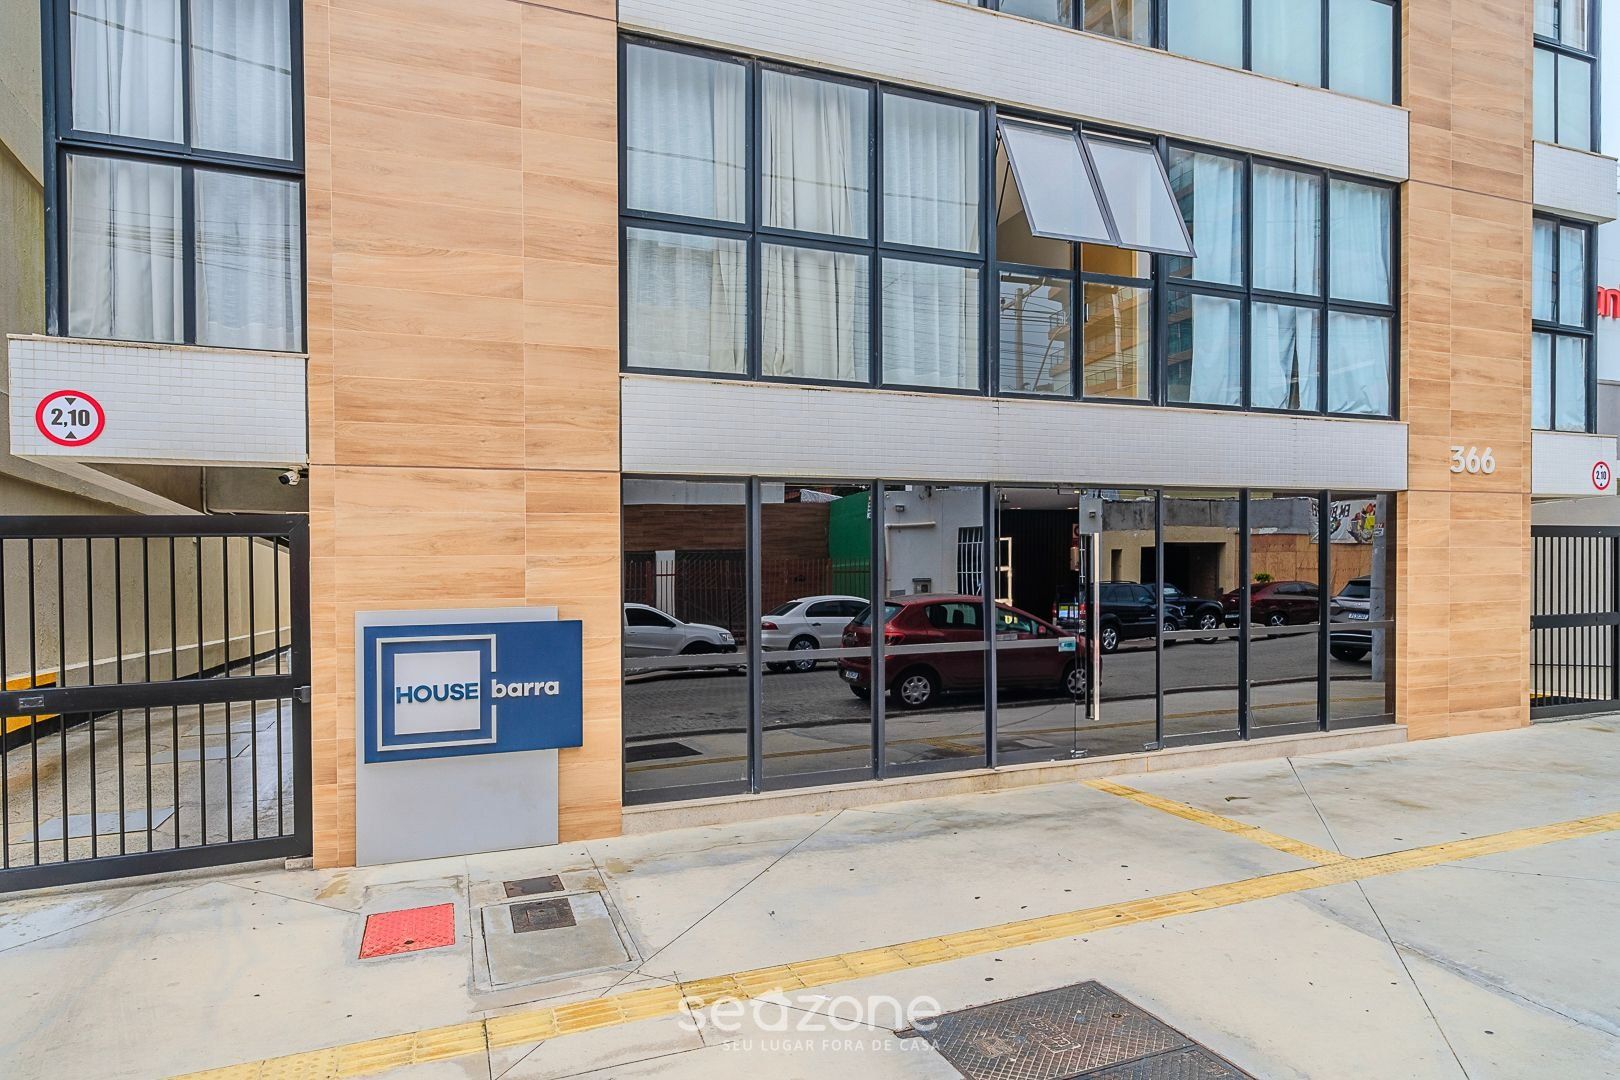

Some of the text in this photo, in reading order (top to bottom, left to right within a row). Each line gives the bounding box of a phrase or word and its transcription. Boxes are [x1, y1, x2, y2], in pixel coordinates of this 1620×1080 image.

[51, 408, 90, 428] 2,10
[1450, 446, 1496, 474] 366
[396, 679, 560, 704] HOUSE barra
